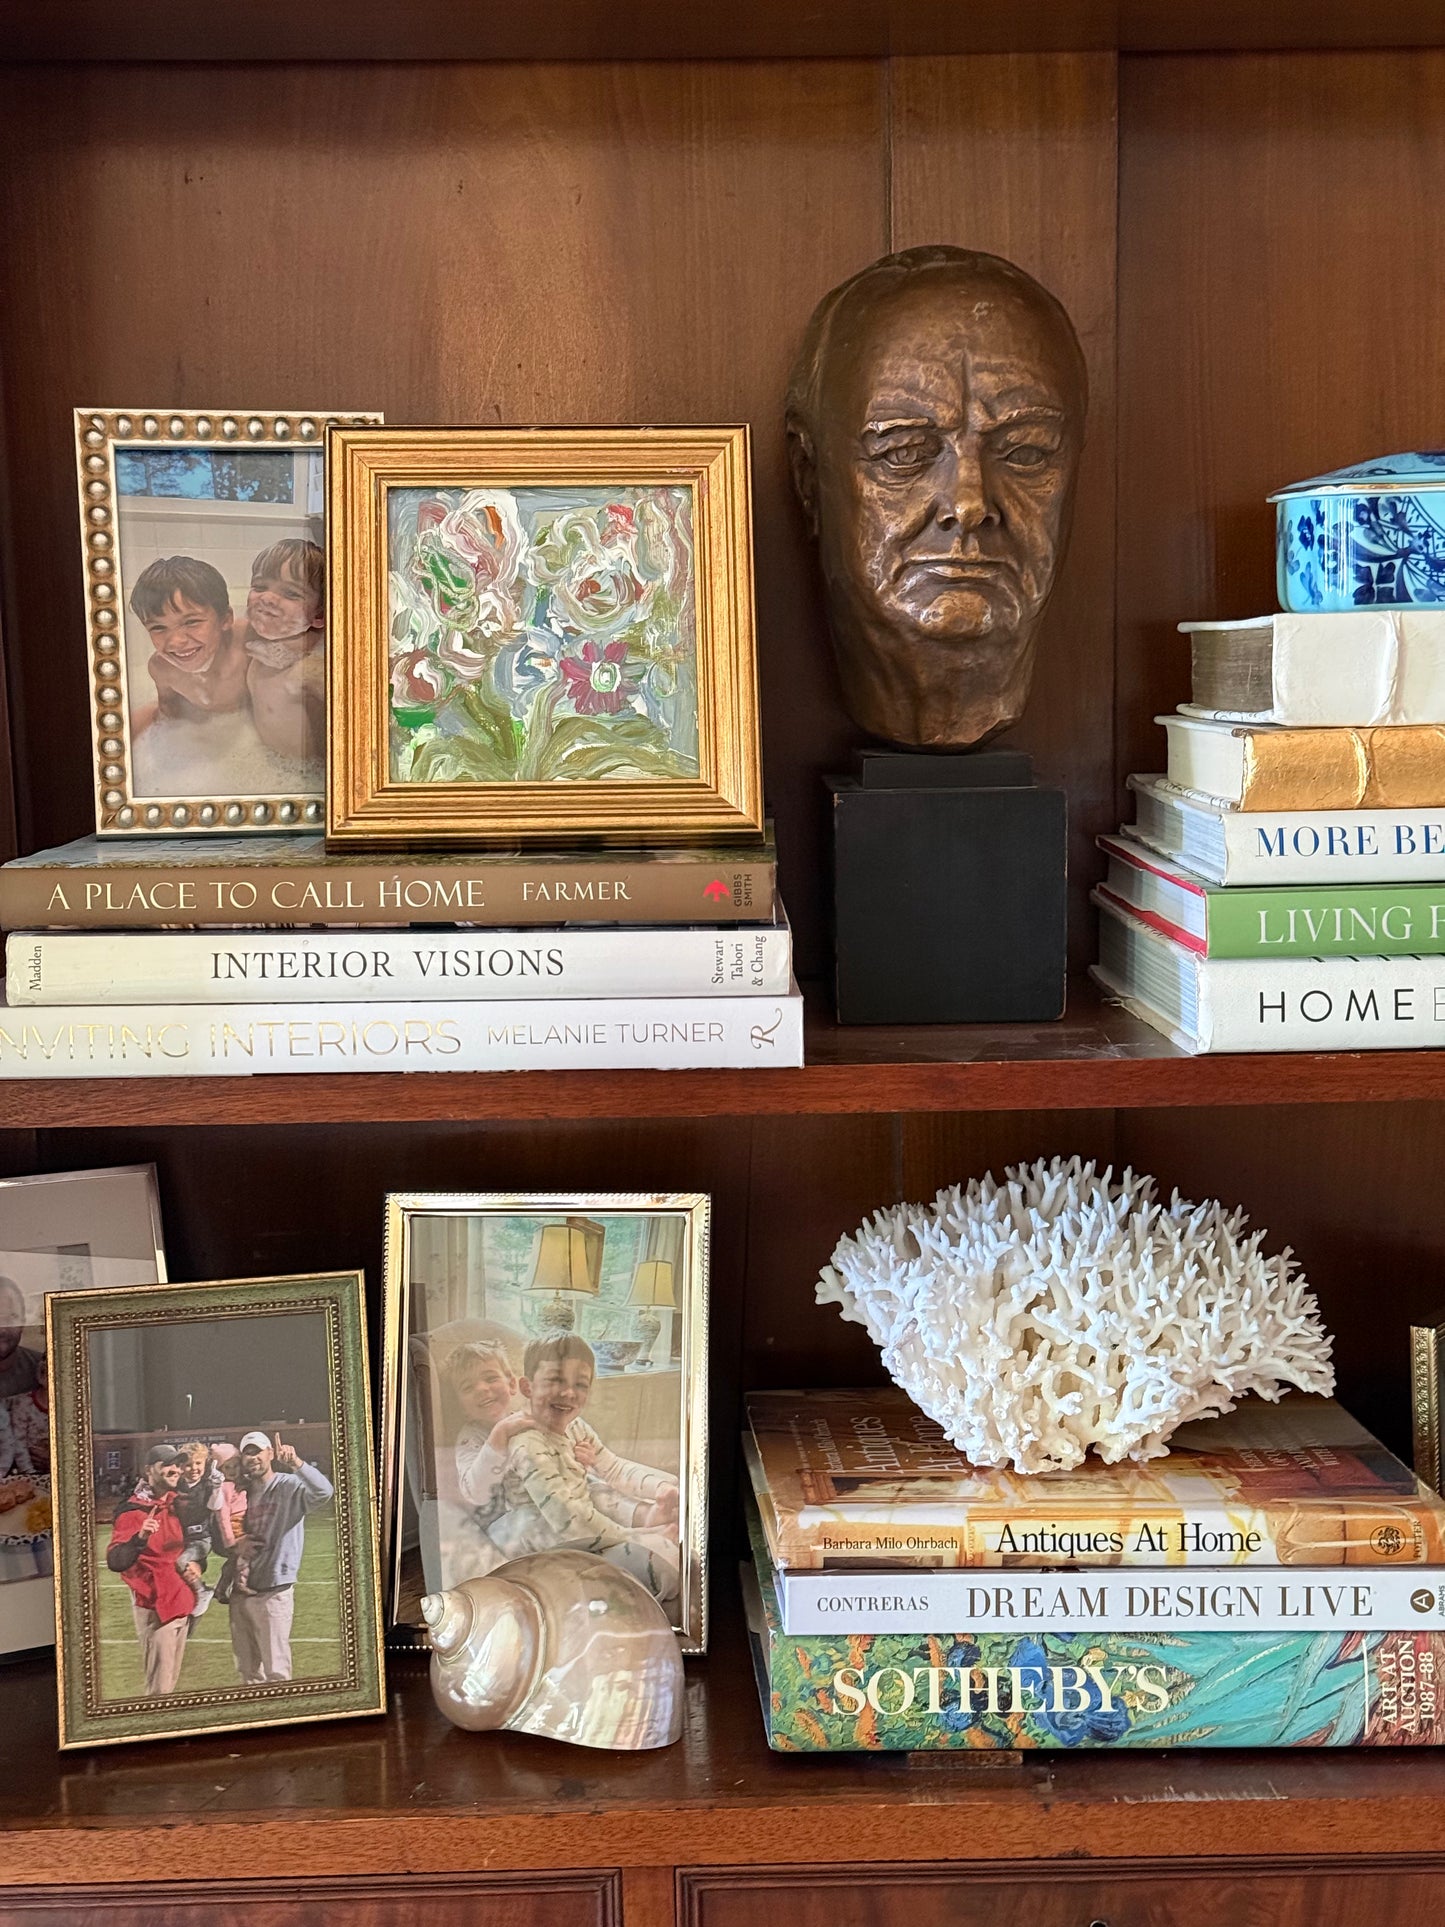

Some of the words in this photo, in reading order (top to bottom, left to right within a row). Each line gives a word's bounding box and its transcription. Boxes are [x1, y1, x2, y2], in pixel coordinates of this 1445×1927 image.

[1255, 826, 1379, 858] MORE
[47, 882, 70, 910] A
[85, 882, 197, 910] PLACE
[209, 882, 258, 909] TO
[271, 880, 364, 909] CALL
[379, 880, 485, 908] HOME
[522, 881, 632, 901] FARMER
[733, 874, 742, 907] GIBBS
[743, 874, 753, 906] SMITH
[1257, 906, 1413, 944] LIVING
[29, 944, 42, 992] Madden
[211, 951, 394, 980] INTERIOR
[413, 949, 564, 978] VISIONS
[711, 940, 724, 984] Stewart
[730, 943, 743, 980] Tabori
[751, 936, 767, 973] Chang
[751, 977, 763, 986] &
[1259, 989, 1414, 1023] HOME
[211, 1020, 461, 1057] INTERIORS
[488, 1024, 607, 1046] MELANIE
[615, 1021, 725, 1043] TURNER
[847, 1416, 904, 1474] Antiques
[917, 1457, 968, 1474] At
[823, 1536, 872, 1550] Barbara
[875, 1536, 904, 1550] Milo
[906, 1535, 958, 1550] Ohrbach
[995, 1524, 1123, 1555] Antiques
[1133, 1523, 1170, 1552] At
[1179, 1522, 1261, 1552] Home
[1413, 1521, 1422, 1559] POTTER
[817, 1595, 929, 1612] CONTRERAS
[966, 1587, 1109, 1618] DREAM
[1124, 1586, 1263, 1617] DESIGN
[1278, 1585, 1374, 1617] LIVE
[1380, 1648, 1397, 1677] AT
[831, 1666, 1170, 1715] SOTHEBY'S
[1381, 1680, 1398, 1725] ART
[1398, 1639, 1416, 1733] AUCTION
[1418, 1651, 1435, 1721] 1987-88
